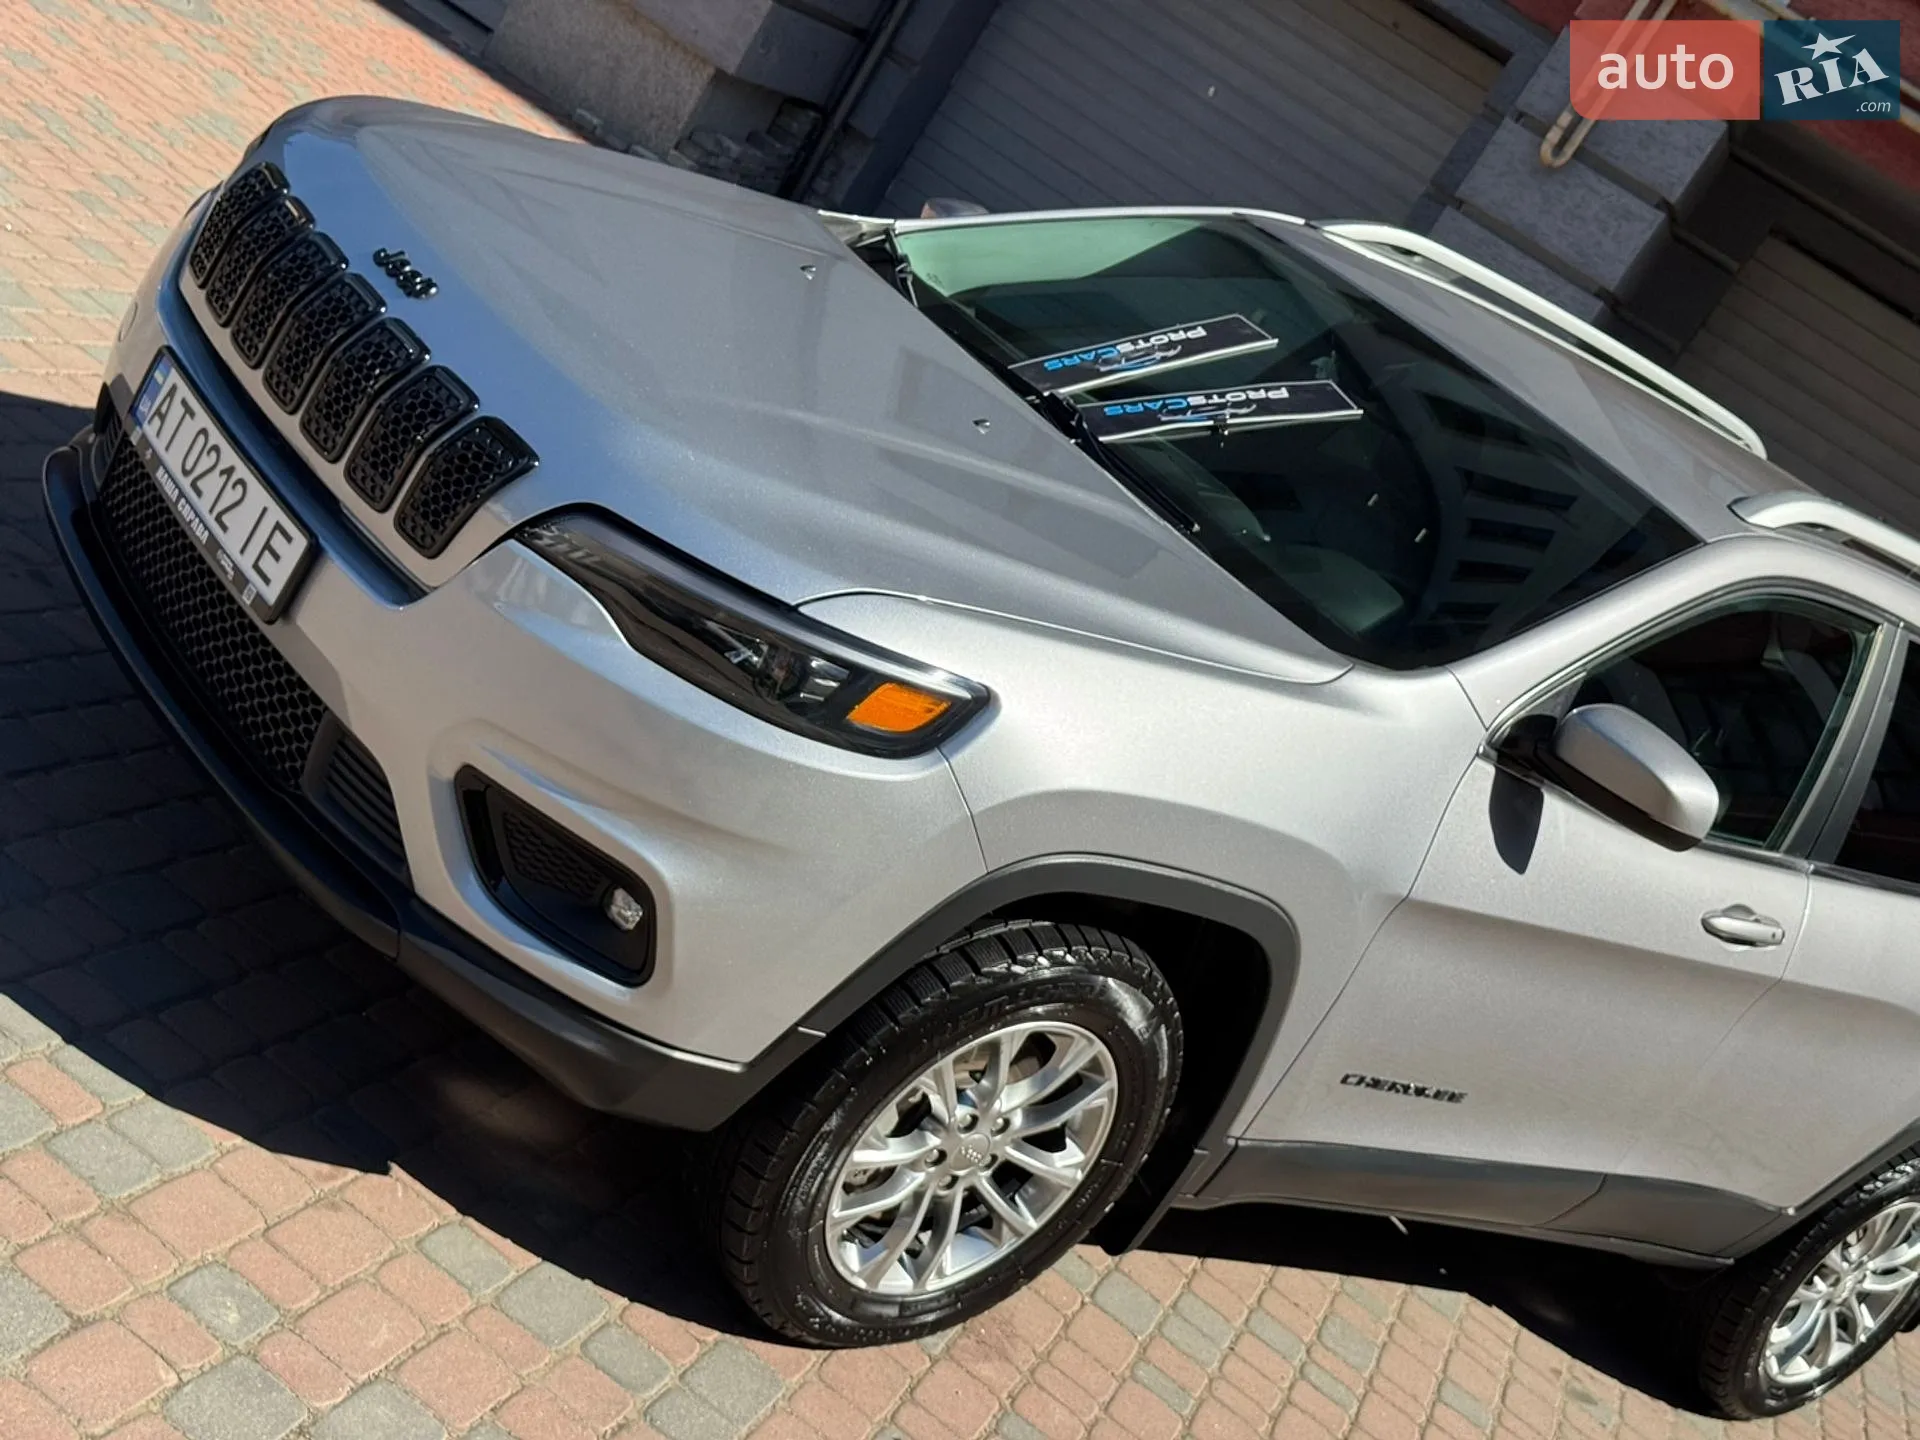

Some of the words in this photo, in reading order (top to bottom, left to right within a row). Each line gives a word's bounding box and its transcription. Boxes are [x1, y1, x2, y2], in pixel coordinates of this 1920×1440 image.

[147, 382, 195, 452] AT
[181, 427, 247, 533] 0212
[239, 505, 294, 587] IE
